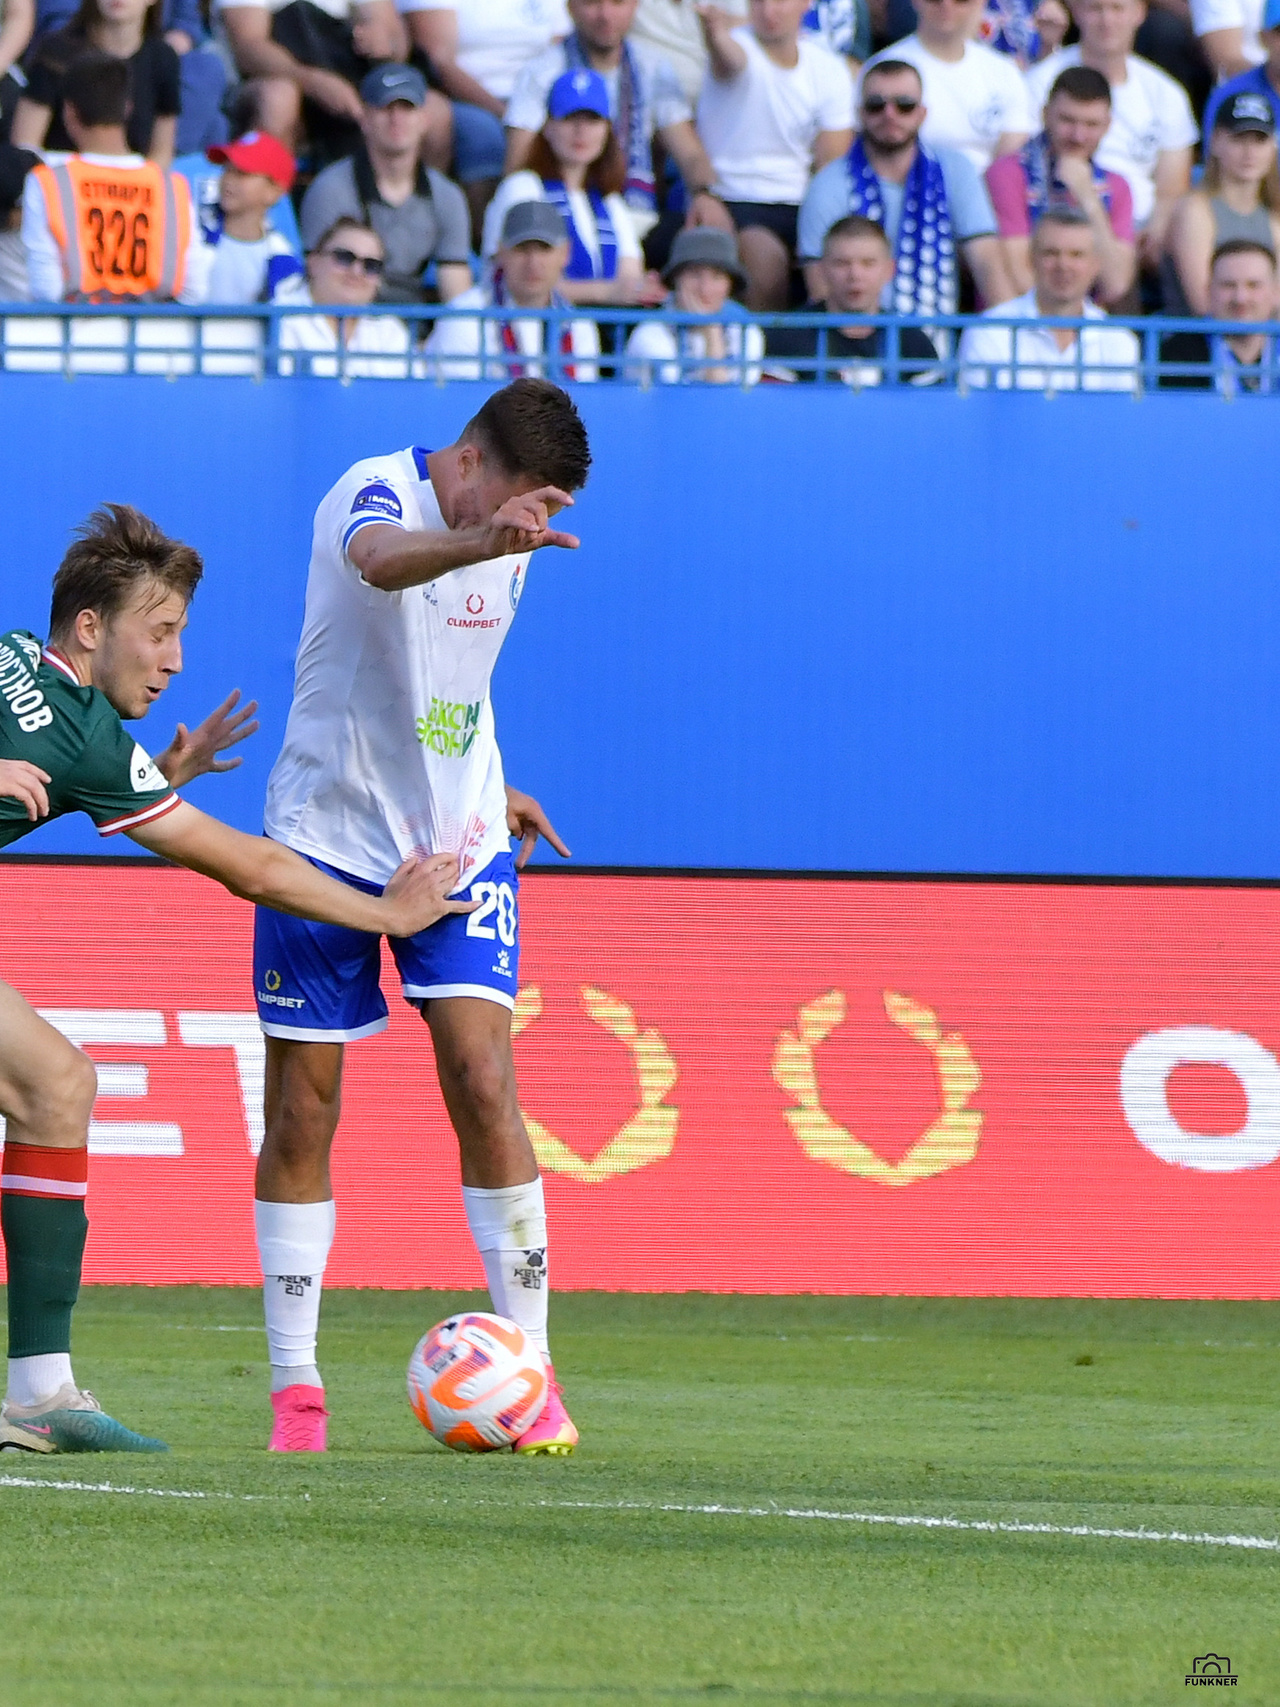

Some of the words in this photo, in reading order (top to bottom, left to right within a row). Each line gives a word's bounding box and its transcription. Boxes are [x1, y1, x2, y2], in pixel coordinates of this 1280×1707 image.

[88, 207, 149, 278] 326
[446, 617, 502, 629] OLIMPBET
[465, 881, 517, 947] 20
[285, 1283, 304, 1297] 20
[521, 1276, 541, 1290] 20
